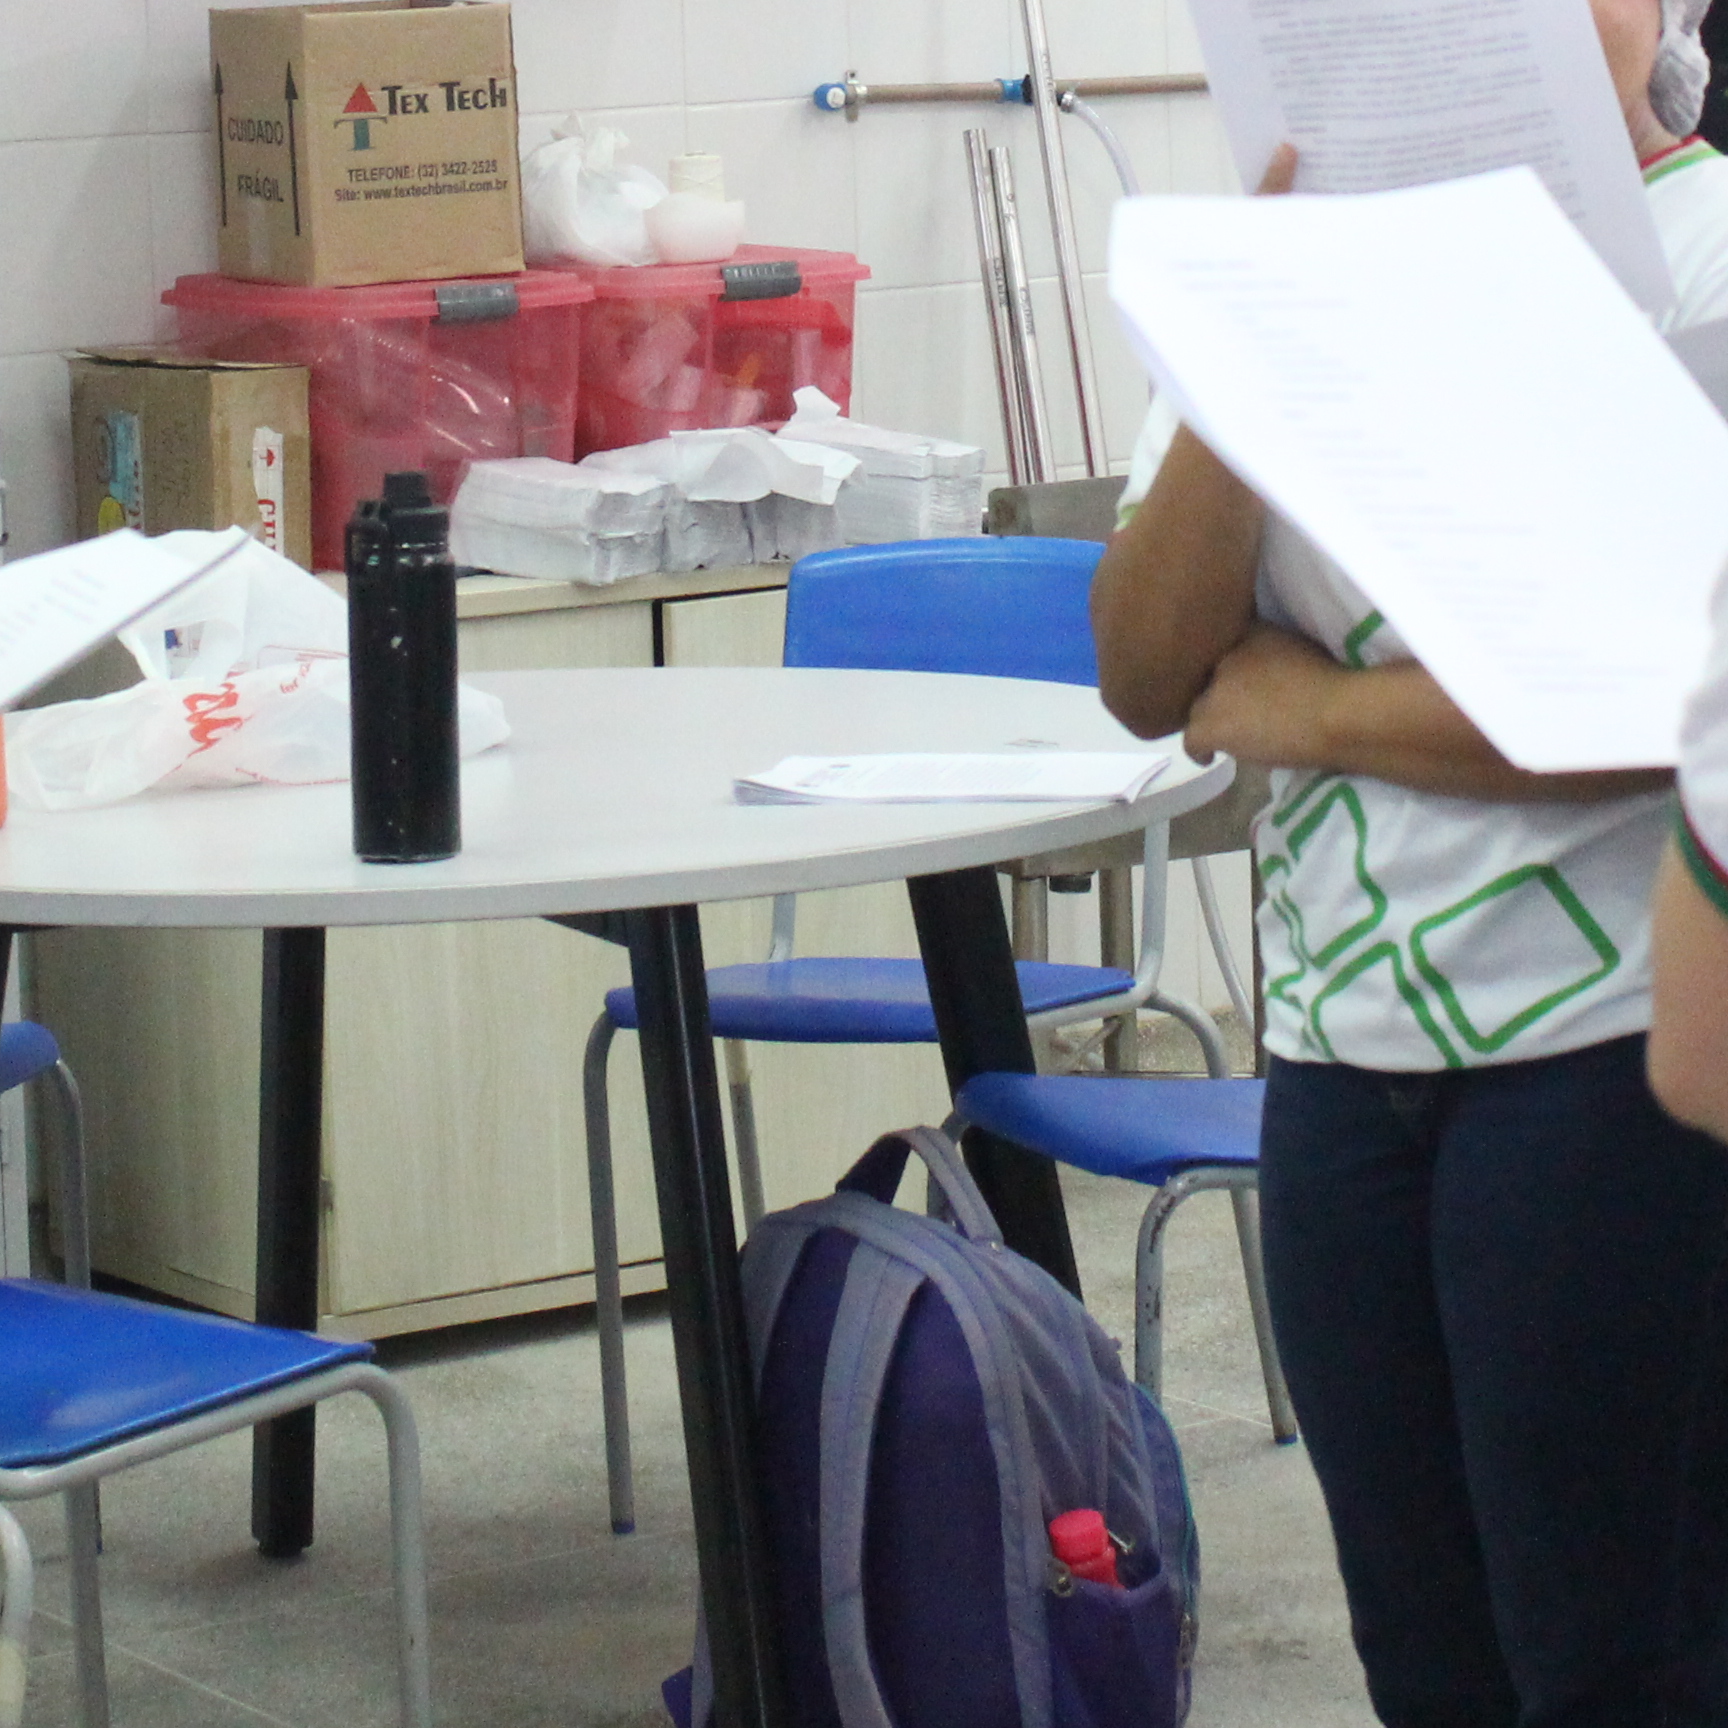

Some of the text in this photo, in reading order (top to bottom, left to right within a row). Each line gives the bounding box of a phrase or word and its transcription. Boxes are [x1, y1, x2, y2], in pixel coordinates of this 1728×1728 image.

[227, 117, 284, 146] CUIDADO
[347, 164, 415, 183] TELEFONE:
[417, 163, 439, 181] (32)
[237, 169, 285, 203] FRÁGIL
[334, 180, 509, 202] Site: www.textechbrasil.com.br
